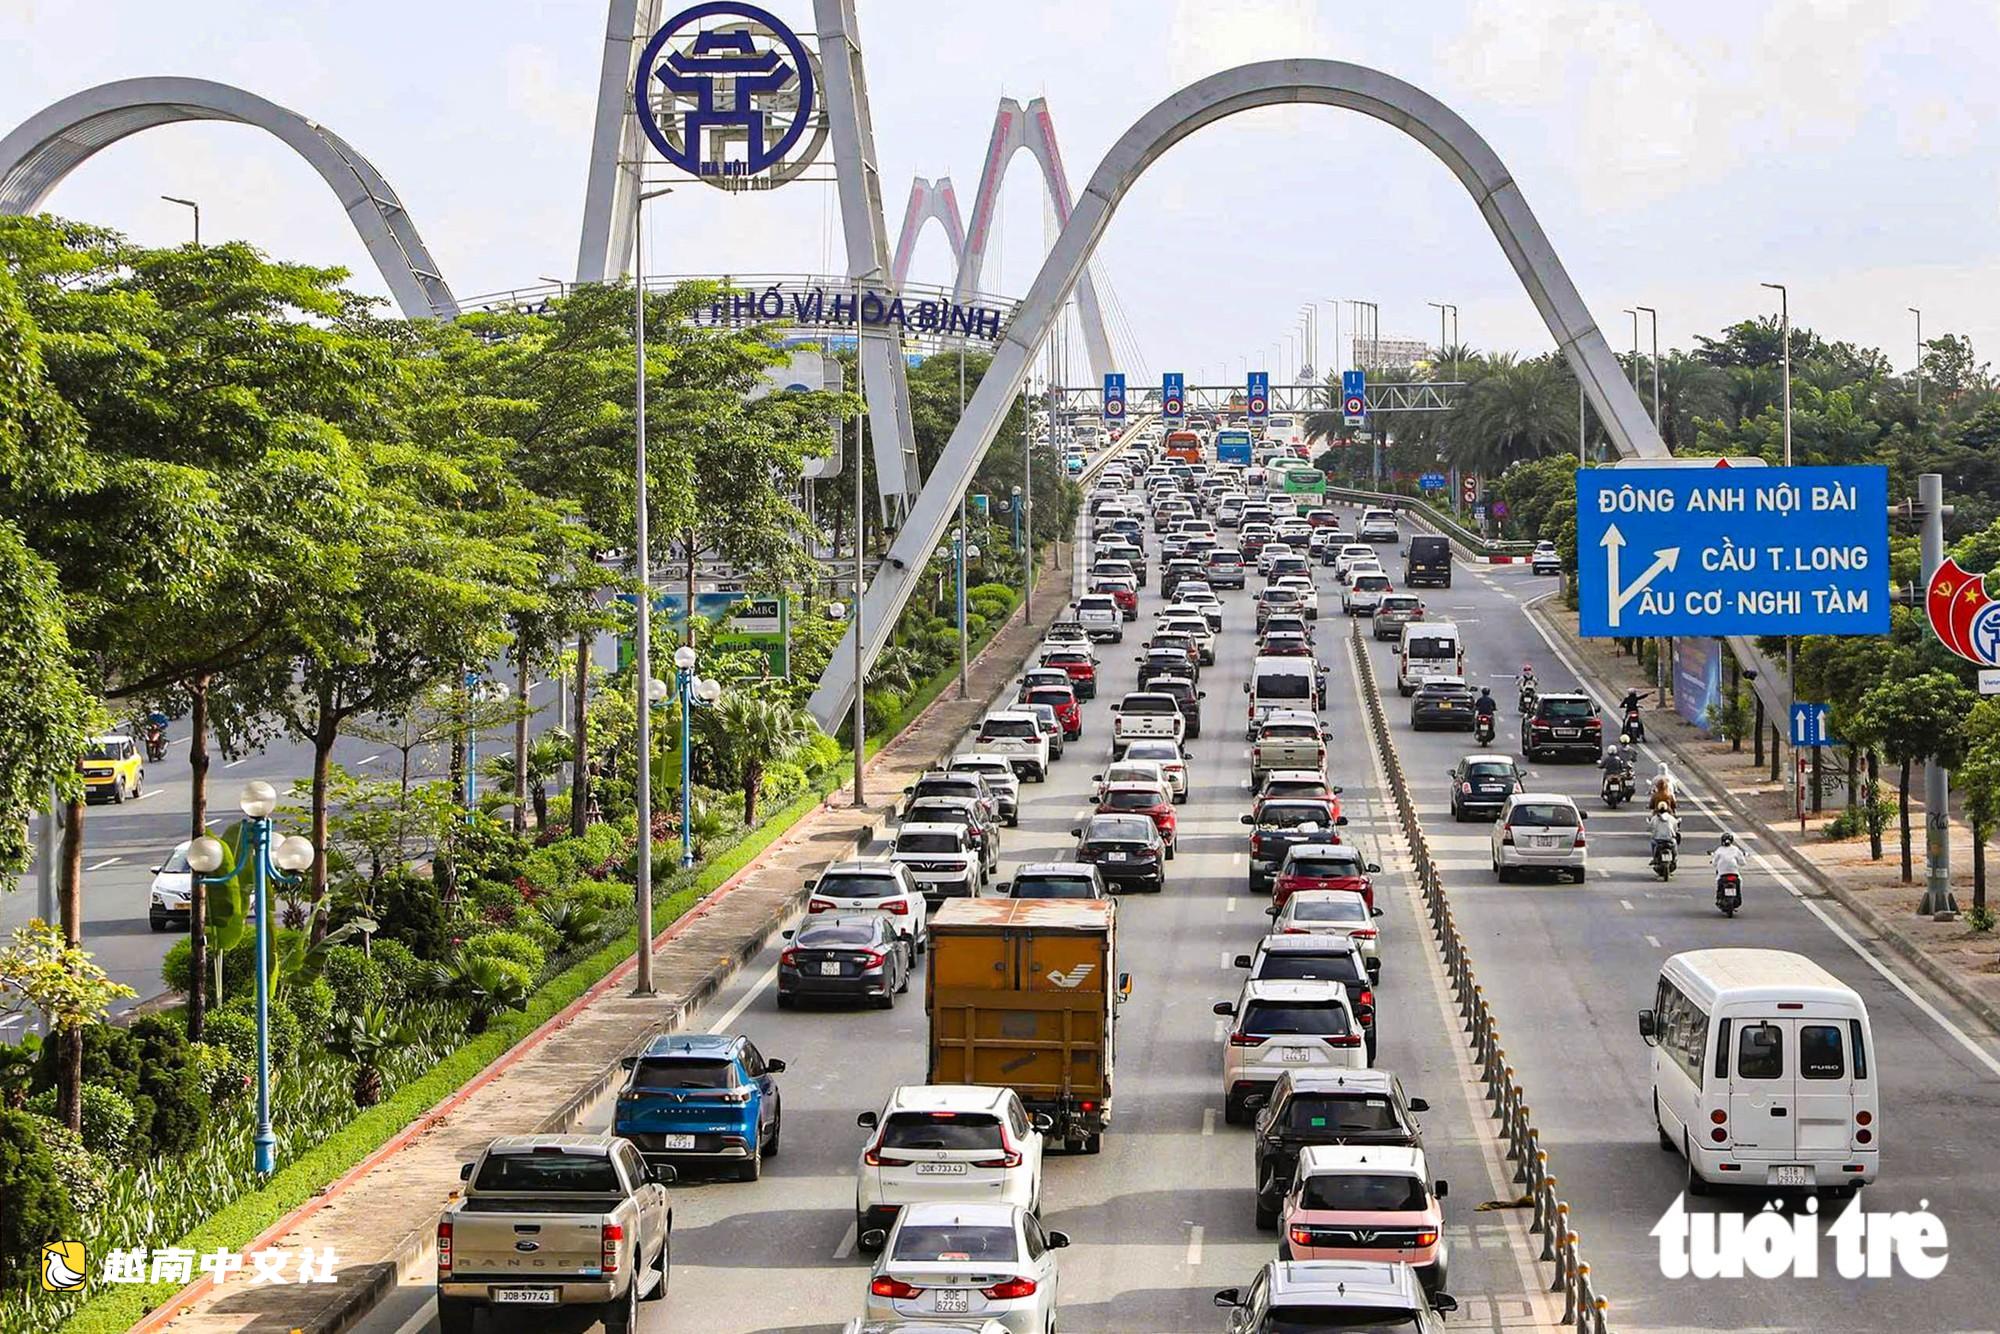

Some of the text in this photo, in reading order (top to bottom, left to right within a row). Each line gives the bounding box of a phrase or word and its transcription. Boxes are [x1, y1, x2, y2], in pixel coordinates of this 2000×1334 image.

[1598, 481, 1857, 517] ĐÔNG ANH NỘI BÀI
[1702, 536, 1868, 571] CẦU T.LONG
[1638, 587, 1675, 615] ÂU
[1812, 584, 1868, 614] TÀM
[746, 605, 775, 616] SMBC
[458, 1258, 597, 1268] RANGER
[943, 1289, 960, 1300] 30E
